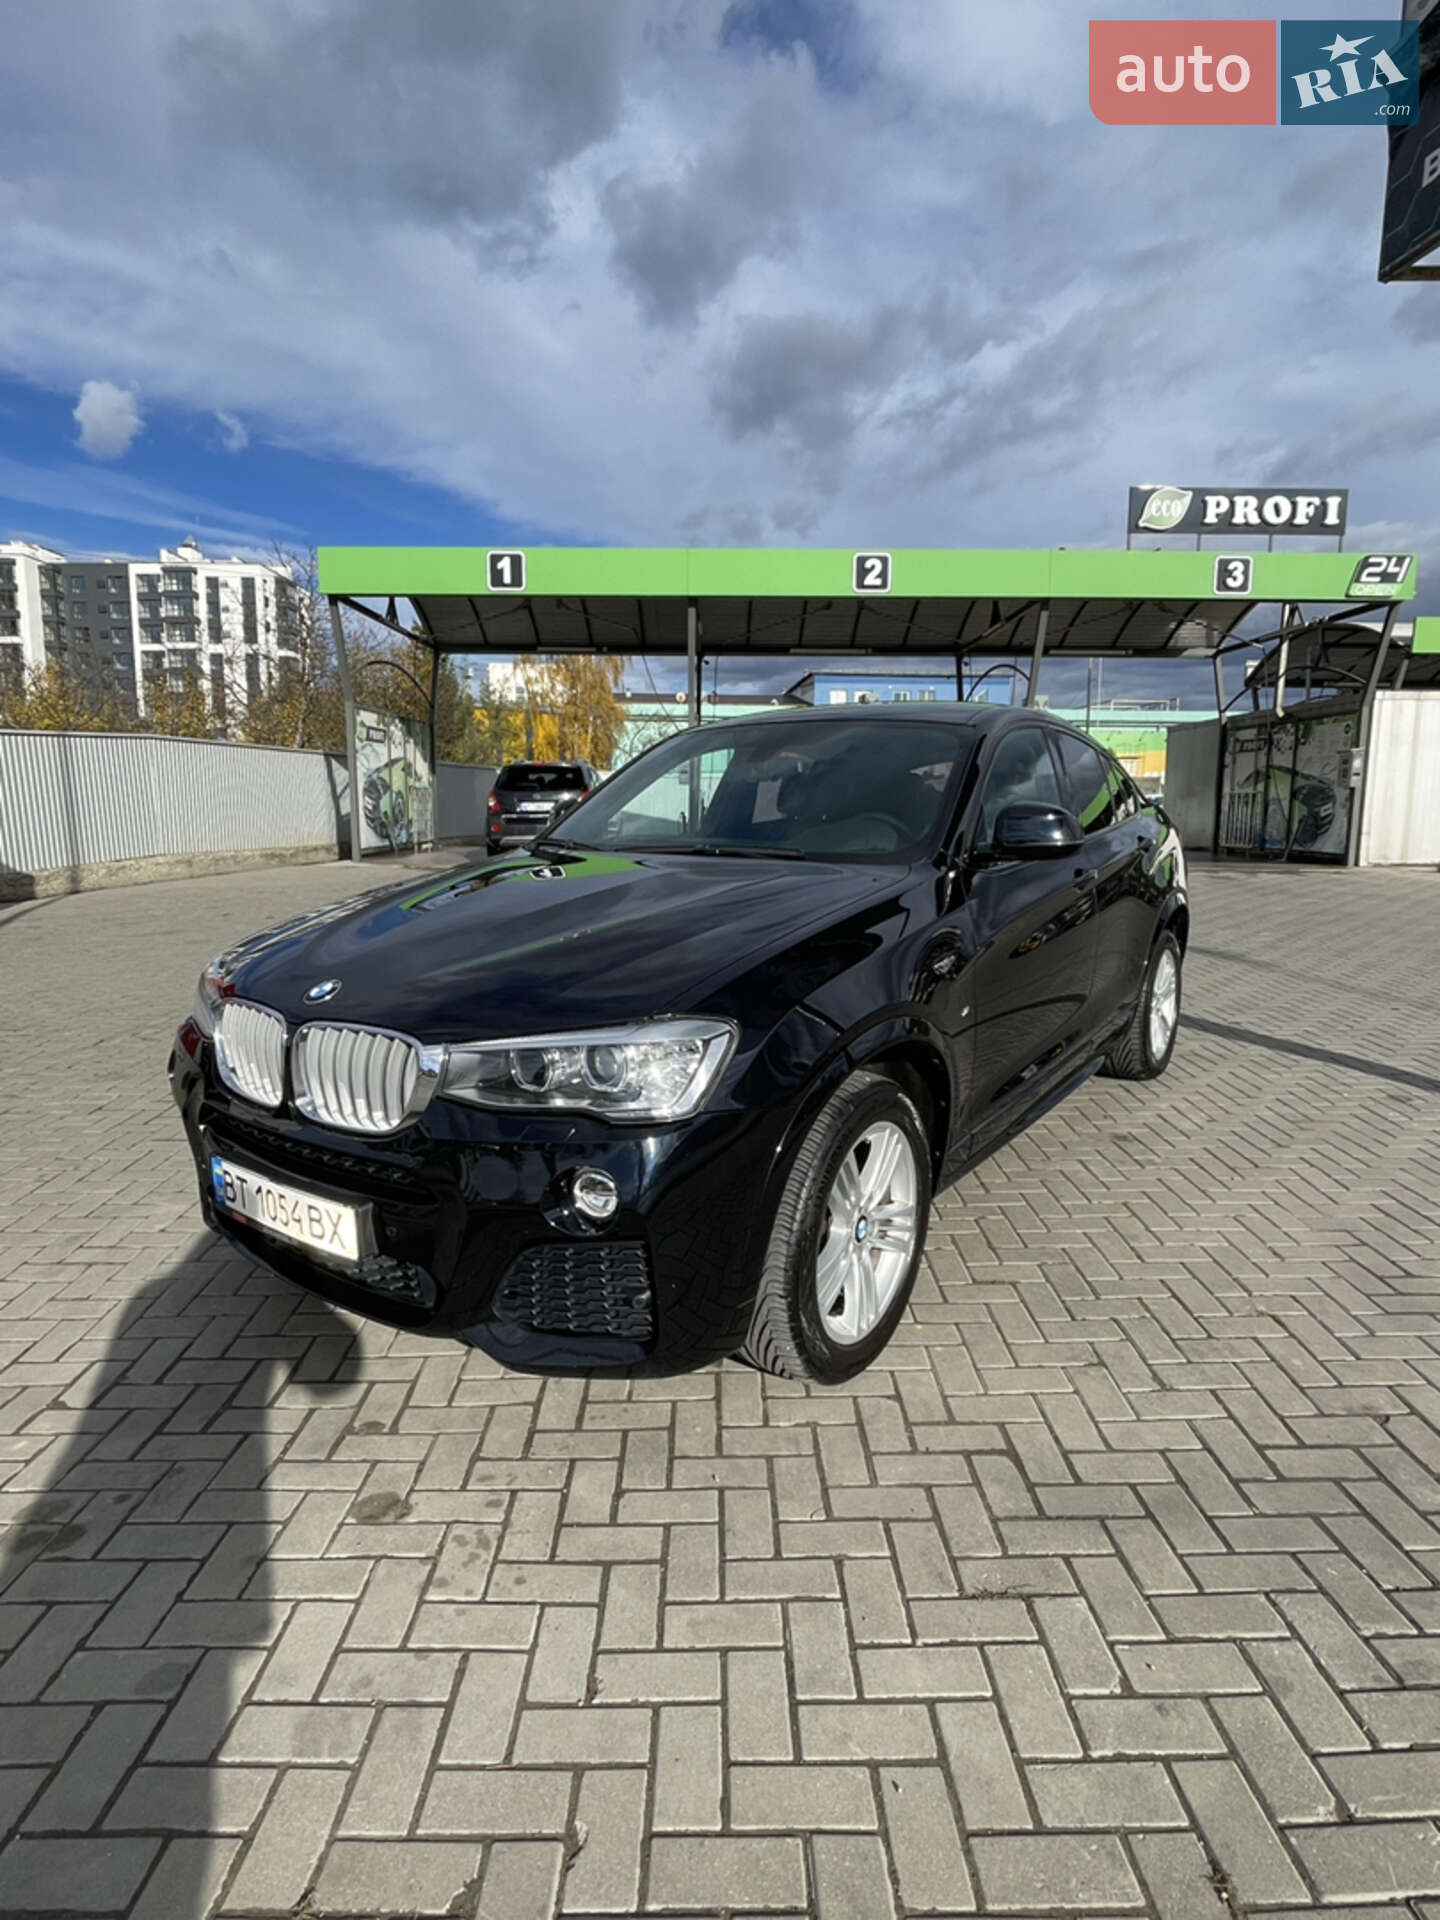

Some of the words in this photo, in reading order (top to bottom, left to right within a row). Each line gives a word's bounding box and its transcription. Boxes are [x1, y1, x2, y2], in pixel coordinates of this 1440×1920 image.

[1203, 495, 1342, 526] PROFI
[496, 555, 511, 585] 1
[863, 558, 883, 586] 2
[1226, 562, 1244, 588] 3
[1359, 556, 1411, 582] 24
[223, 1169, 248, 1210] BT
[255, 1185, 305, 1236] 1054
[307, 1203, 347, 1250] BX
